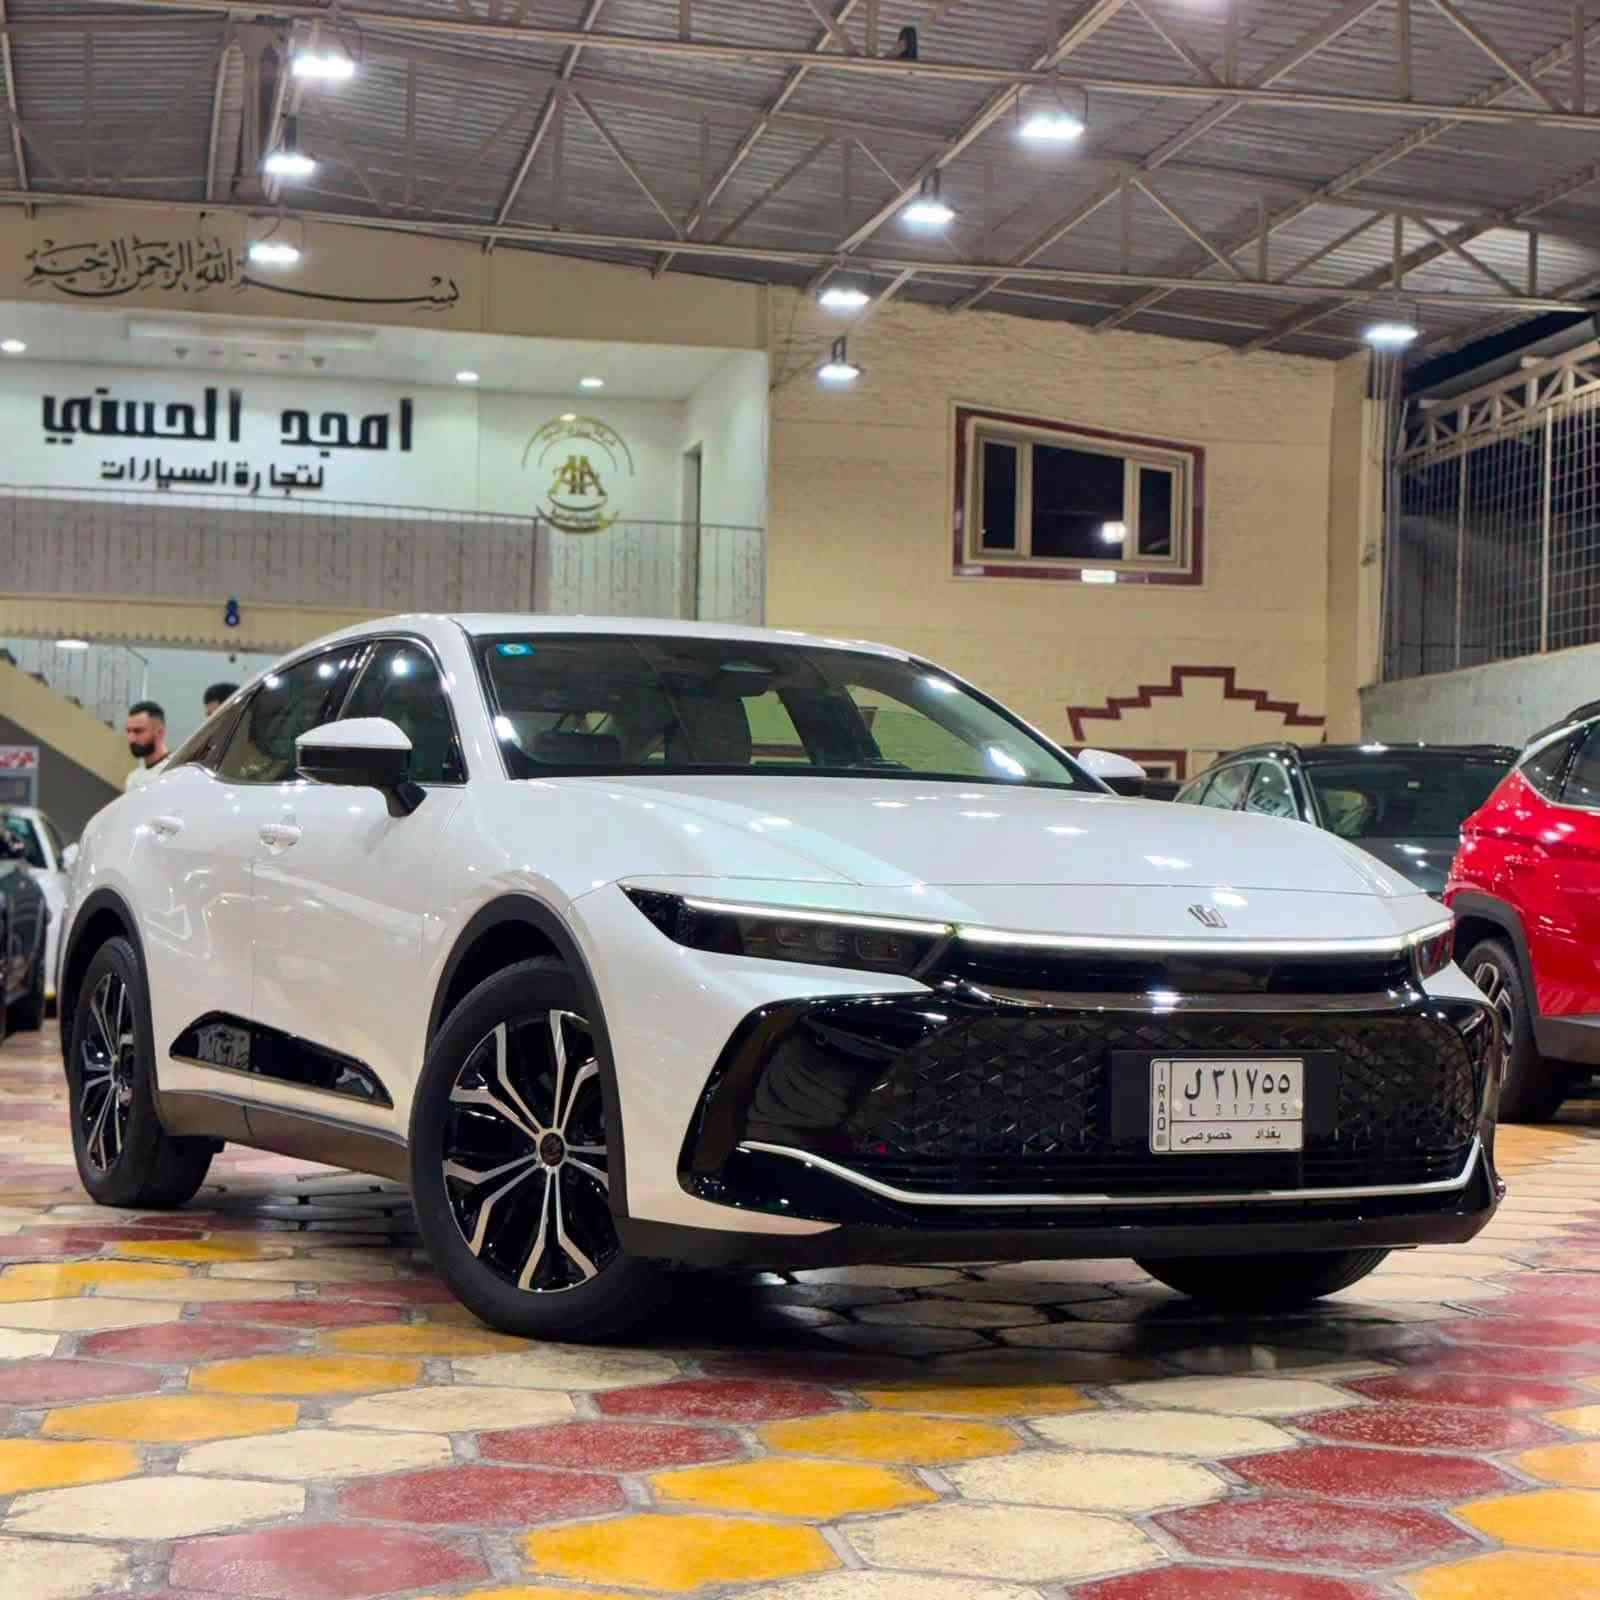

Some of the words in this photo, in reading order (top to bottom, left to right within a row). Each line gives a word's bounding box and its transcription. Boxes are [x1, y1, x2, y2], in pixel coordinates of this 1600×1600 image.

[24, 237, 129, 288] الرحيم
[52, 234, 194, 297] الرحمن
[194, 237, 234, 293] الله
[231, 256, 460, 312] بسم
[42, 387, 242, 445] الحسني
[281, 398, 414, 457] امجد
[101, 457, 228, 490] السيارات
[234, 463, 324, 496] لتجارة
[1157, 1067, 1167, 1131] IRAQ
[1255, 1125, 1282, 1145] بغداد
